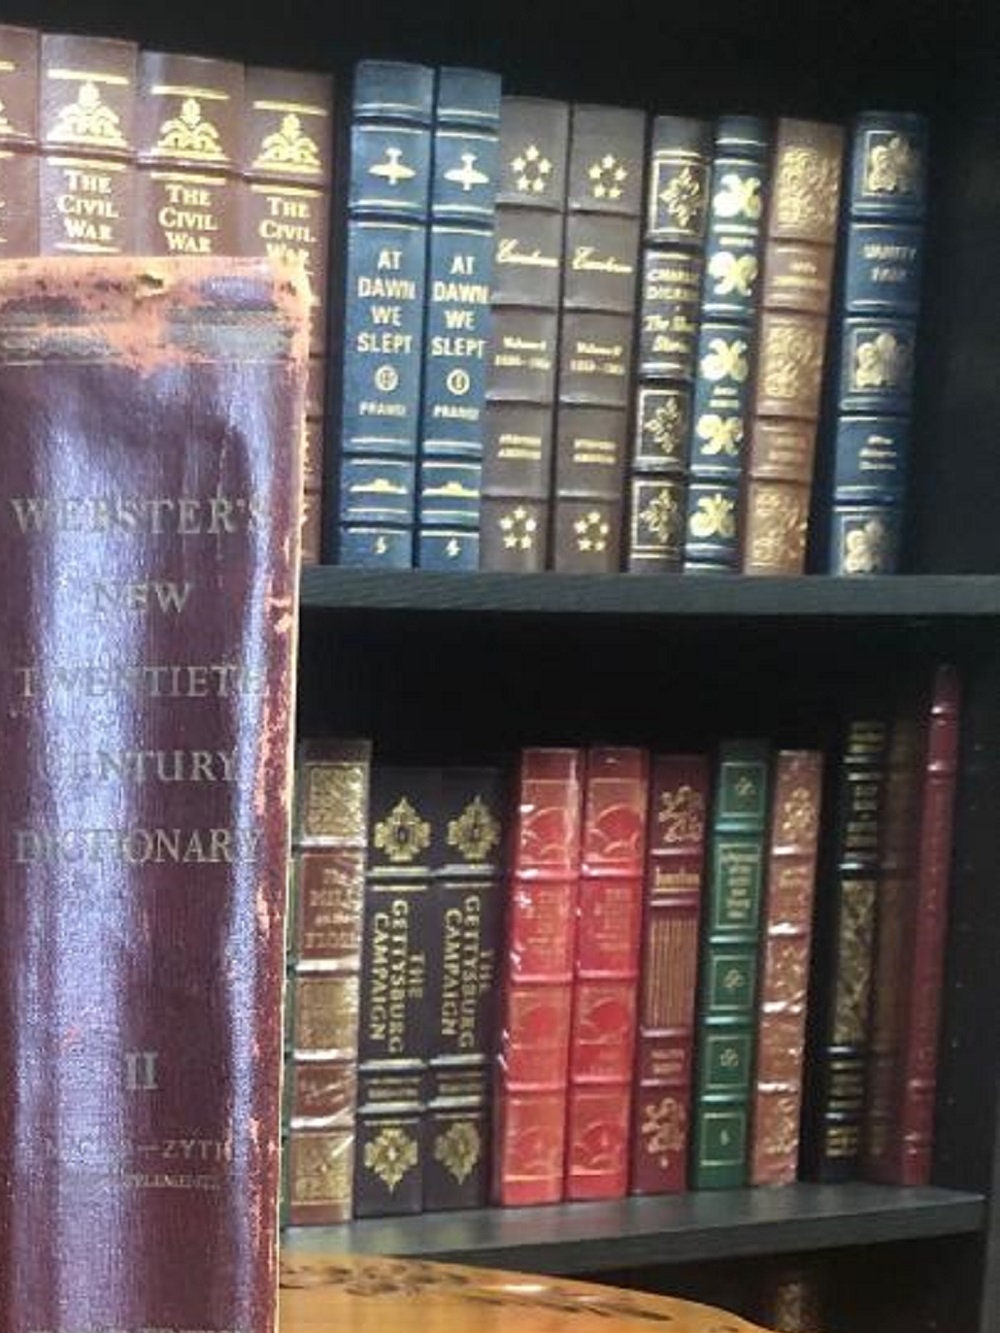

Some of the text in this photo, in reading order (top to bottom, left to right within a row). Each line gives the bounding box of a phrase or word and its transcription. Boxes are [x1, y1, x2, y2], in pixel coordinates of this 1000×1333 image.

[63, 169, 112, 194] THE
[56, 194, 119, 218] CIVIL
[164, 184, 212, 207] THE
[266, 196, 311, 219] THE
[64, 217, 113, 241] WAR
[158, 206, 219, 231] CIVIL
[164, 231, 212, 253] WAR
[259, 219, 318, 243] CIVIL
[376, 250, 403, 270] AT
[450, 255, 477, 275] AT
[357, 275, 417, 300] DAWN
[433, 280, 491, 305] DAWN
[370, 305, 404, 327] WE
[443, 309, 477, 331] WE
[357, 332, 414, 355] SLEPT
[431, 336, 488, 359] SLEPT
[38, 749, 241, 783] ENTURY
[369, 911, 390, 1041] CAMPAIGN
[388, 898, 409, 1054] GETTYSBURG
[441, 907, 462, 1036] CAMPAIGN
[459, 894, 480, 1049] GETTYSBURG
[123, 1050, 160, 1091] II
